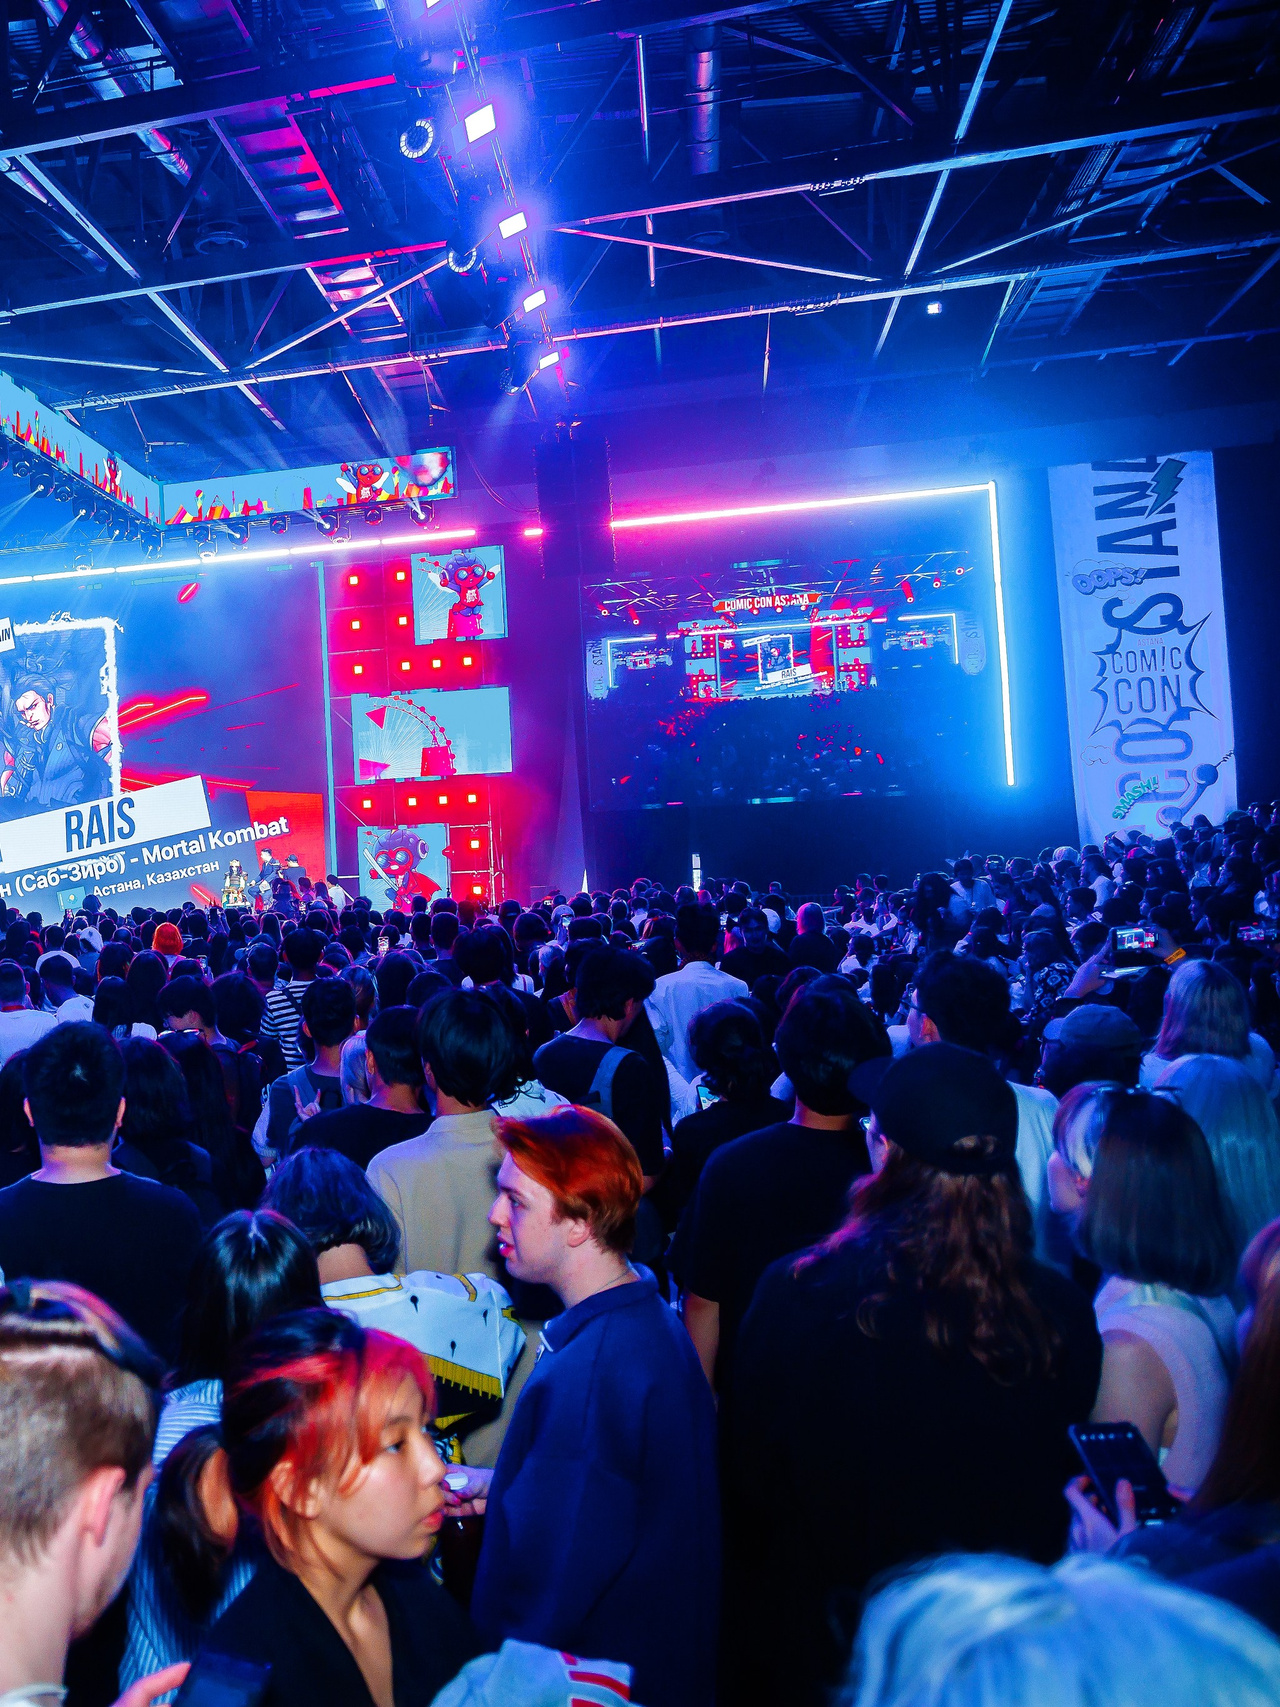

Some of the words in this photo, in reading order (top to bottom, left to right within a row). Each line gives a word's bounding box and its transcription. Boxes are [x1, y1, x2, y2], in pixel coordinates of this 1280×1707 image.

[1072, 567, 1147, 595] OOPS!
[724, 598, 753, 611] COMIC
[754, 596, 773, 608] CON
[1137, 637, 1164, 646] ASTANA
[1114, 674, 1182, 714] CON
[1112, 776, 1159, 820] SMASH!
[65, 797, 136, 853] RAIS
[141, 834, 206, 866] Mortal
[208, 816, 290, 850] Kombat
[93, 878, 145, 899] Астана,
[146, 860, 220, 887] Казахстан
